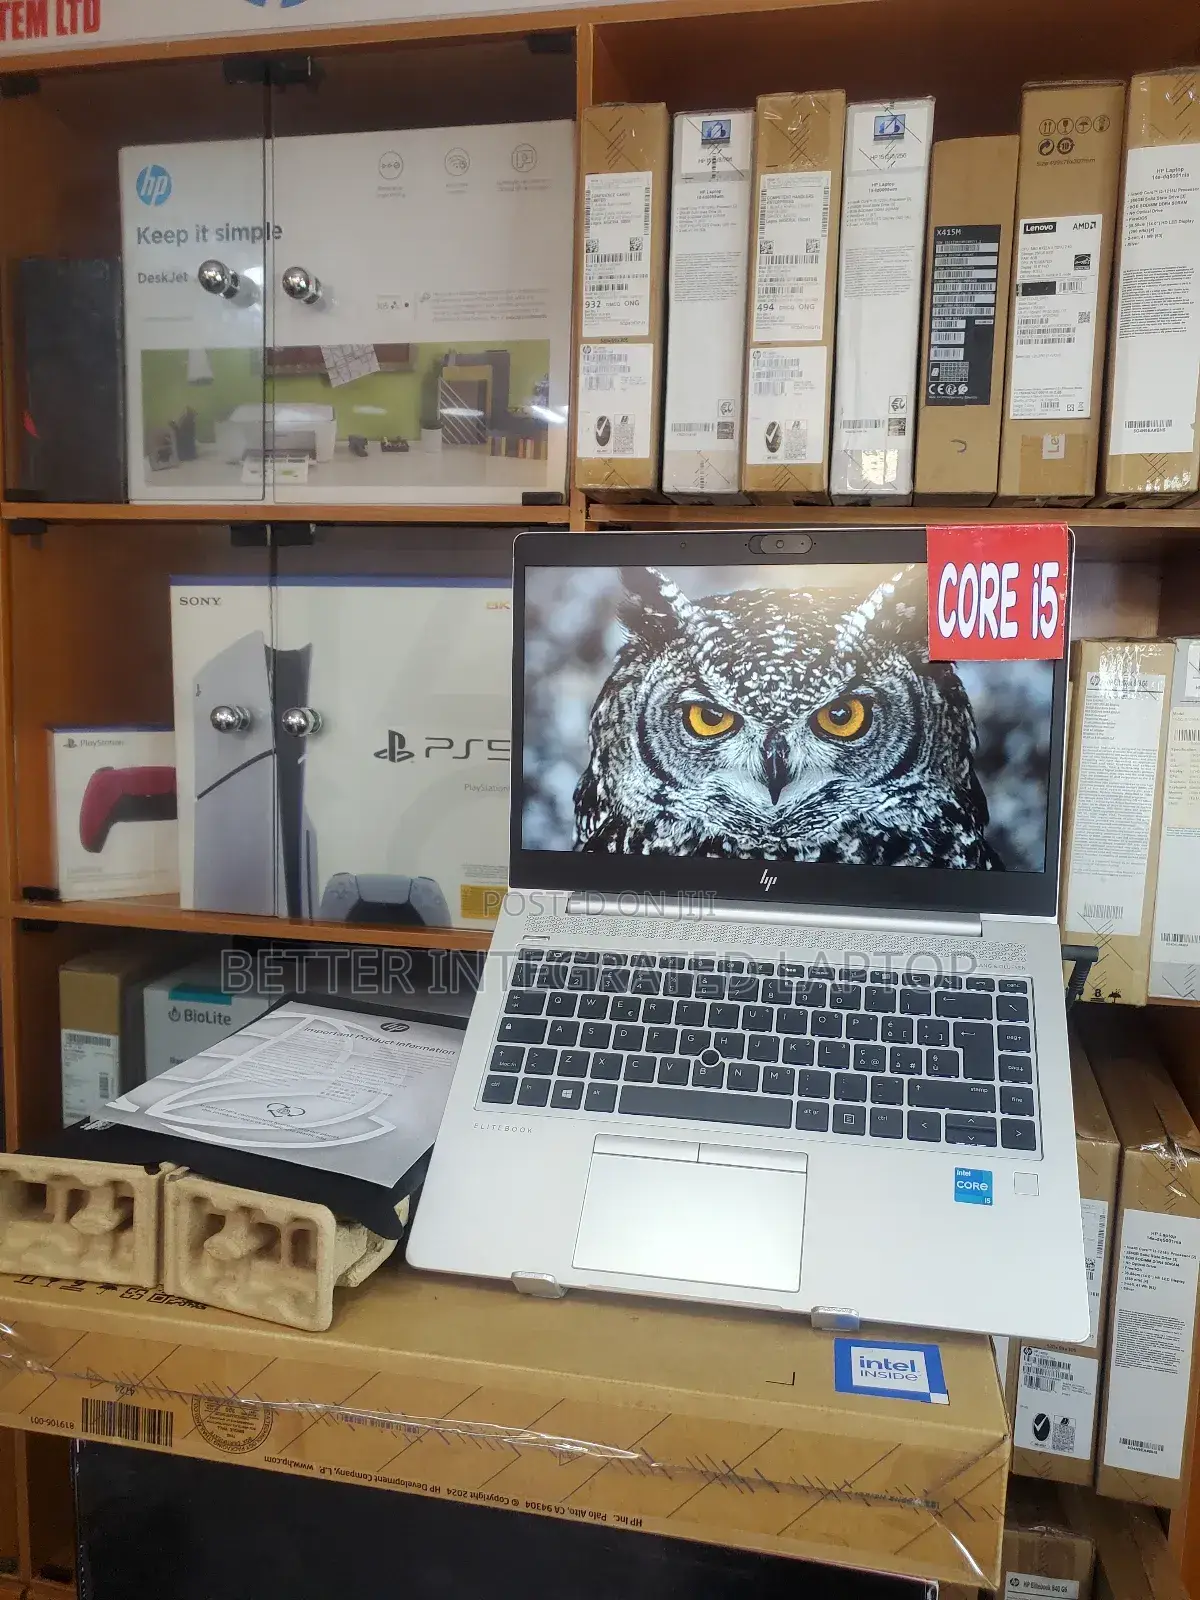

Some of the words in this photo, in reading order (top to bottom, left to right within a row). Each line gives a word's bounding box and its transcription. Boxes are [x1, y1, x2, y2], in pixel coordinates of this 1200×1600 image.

[56, 0, 101, 35] LTD
[139, 165, 170, 206] hp
[936, 228, 962, 236] X415M
[1025, 223, 1054, 232] Lenovo
[1072, 222, 1090, 230] AMD
[137, 226, 189, 246] Keep
[195, 224, 210, 242] it
[215, 221, 283, 246] simple
[137, 271, 189, 284] DeskJet
[585, 300, 602, 310] 932
[757, 303, 774, 312] 494
[179, 596, 221, 606] SONY
[938, 562, 1020, 639] CORE
[1031, 561, 1060, 640] i5
[80, 738, 124, 748] PlayStation
[424, 736, 511, 761] PS5
[464, 782, 511, 794] PlayStation
[760, 869, 778, 892] hp
[184, 1008, 232, 1026] BioLite
[304, 1027, 354, 1039] Important
[356, 1034, 394, 1046] Product
[396, 1040, 456, 1056] Information
[871, 1058, 880, 1066] @
[770, 1072, 778, 1080] M
[474, 1122, 532, 1134] ELITEBOOK
[860, 1356, 916, 1373] intel
[29, 1414, 76, 1430] 819106-001
[264, 1455, 314, 1471] www.hp.com
[319, 1465, 333, 1475] L.P.
[334, 1467, 373, 1482] Company,
[374, 1474, 428, 1492] Development
[430, 1486, 441, 1494] HP
[446, 1487, 468, 1498] 2024
[470, 1491, 510, 1506] Copyright
[525, 1500, 553, 1512] 94304
[554, 1505, 566, 1515] CA
[567, 1506, 586, 1518] Alto,
[588, 1510, 607, 1522] Palo
[613, 1514, 628, 1526] Inc.
[630, 1518, 642, 1528] HP
